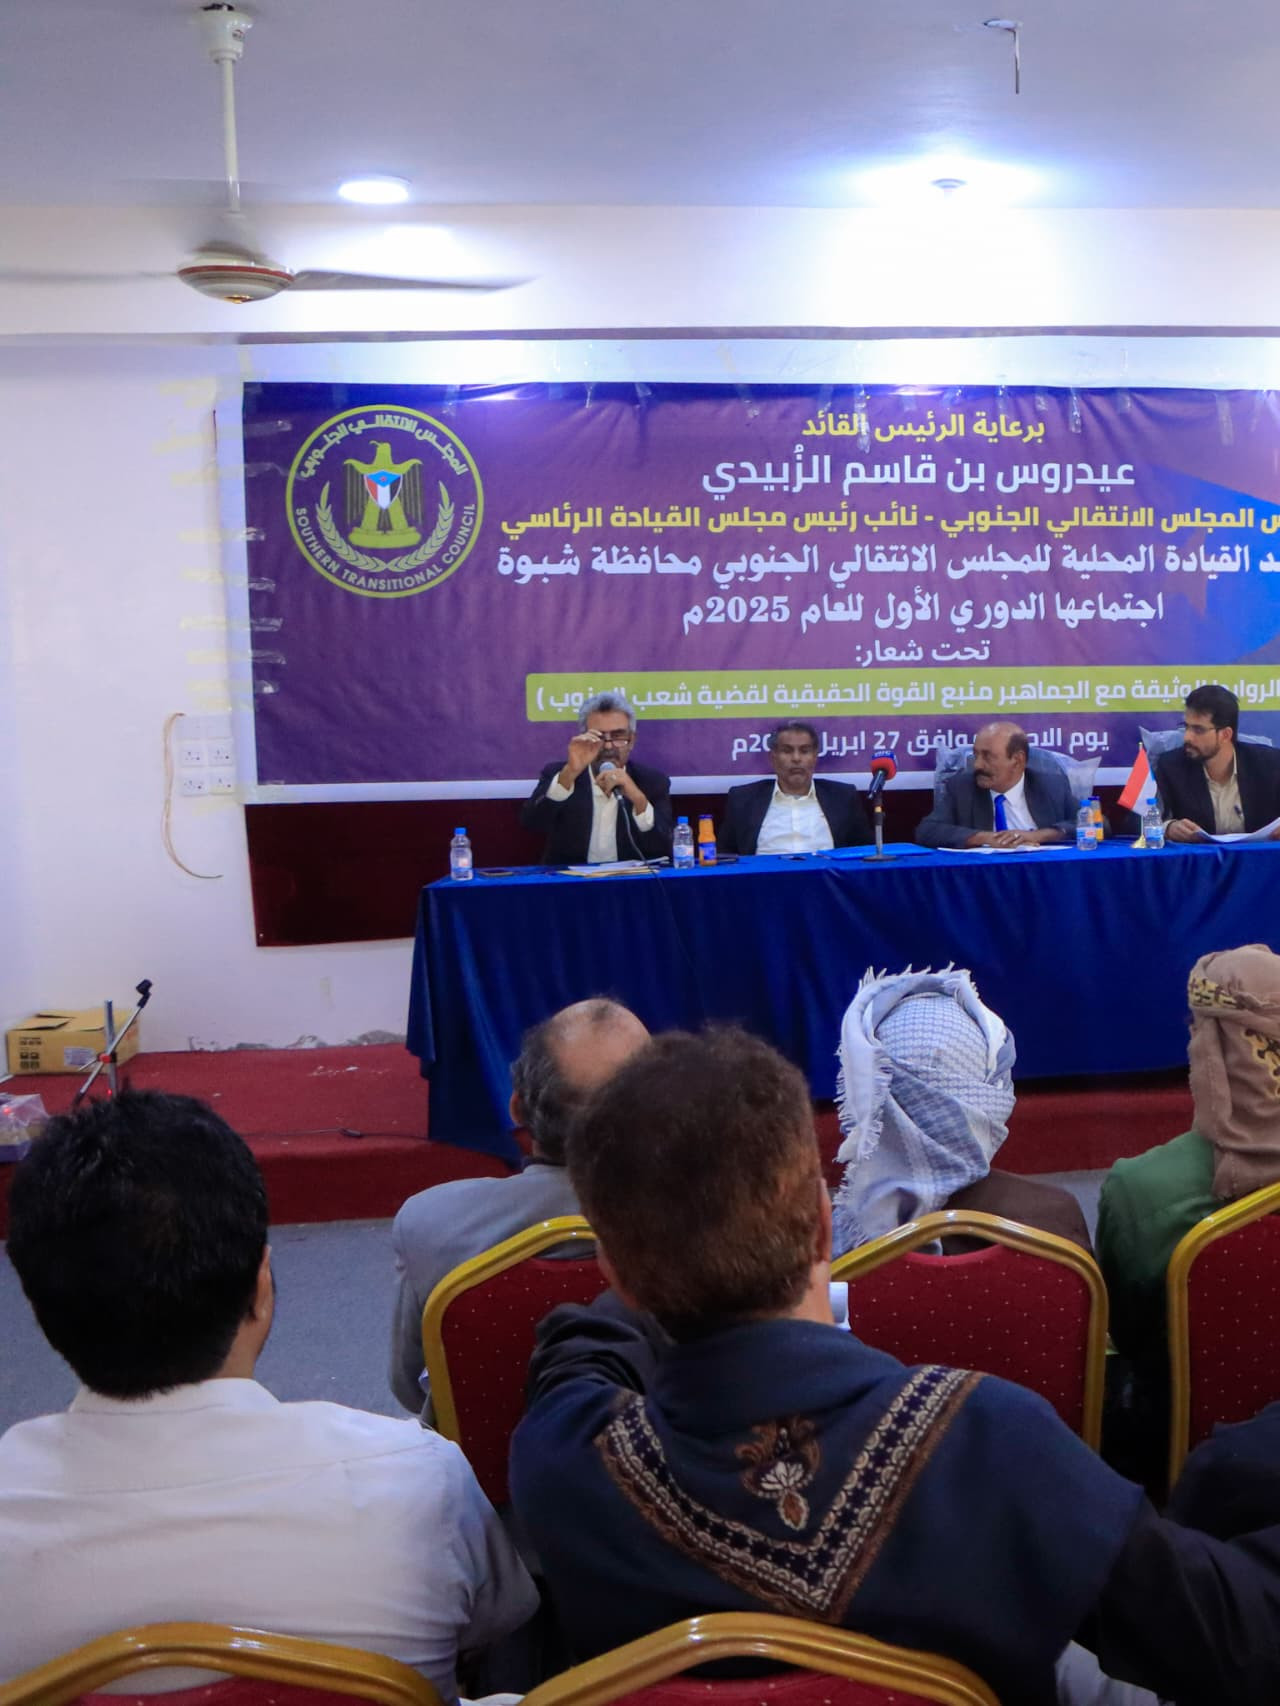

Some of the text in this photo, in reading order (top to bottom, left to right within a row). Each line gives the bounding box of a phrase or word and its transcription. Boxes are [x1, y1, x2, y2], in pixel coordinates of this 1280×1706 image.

[802, 410, 1045, 443] برعاية الرئيس القائد
[842, 454, 937, 497] قاسم
[947, 457, 985, 493] بن
[996, 462, 1135, 493] عيدروس
[501, 502, 603, 541] الرئاسي
[610, 505, 701, 533] القيادة
[708, 506, 787, 533] مجلس
[793, 501, 857, 532] رئيس
[863, 501, 918, 532] نائب
[940, 505, 1039, 538] الجنوبي
[1046, 505, 1154, 538] الانتقالي
[1161, 507, 1254, 533] المجلس
[295, 503, 475, 591] SOUTHERN TRANSITIONAL COUNCIL
[591, 545, 702, 576] محافظة
[946, 543, 1052, 580] للمجلس
[1061, 543, 1155, 580] المحلية
[1164, 543, 1250, 580] القيادة
[497, 543, 580, 585] شبوة
[712, 544, 819, 590] الجنوبي
[829, 543, 937, 589] الانتقالي
[800, 592, 865, 634] للعام
[874, 585, 940, 630] الأول
[950, 591, 1046, 633] الدوري
[1055, 591, 1164, 629] اجتماعها
[855, 639, 991, 668] تحت شعار:
[632, 682, 693, 711] شعب
[697, 683, 768, 710] لقضية
[773, 682, 871, 708] الحقيقية
[876, 681, 936, 707] القوة
[941, 680, 993, 708] منبع
[997, 680, 1090, 706] الجماهير
[1095, 683, 1126, 706] مع
[817, 730, 866, 757] ابريل
[873, 731, 900, 750] 27
[1026, 727, 1062, 747] الاح
[1068, 730, 1110, 754] يوم
